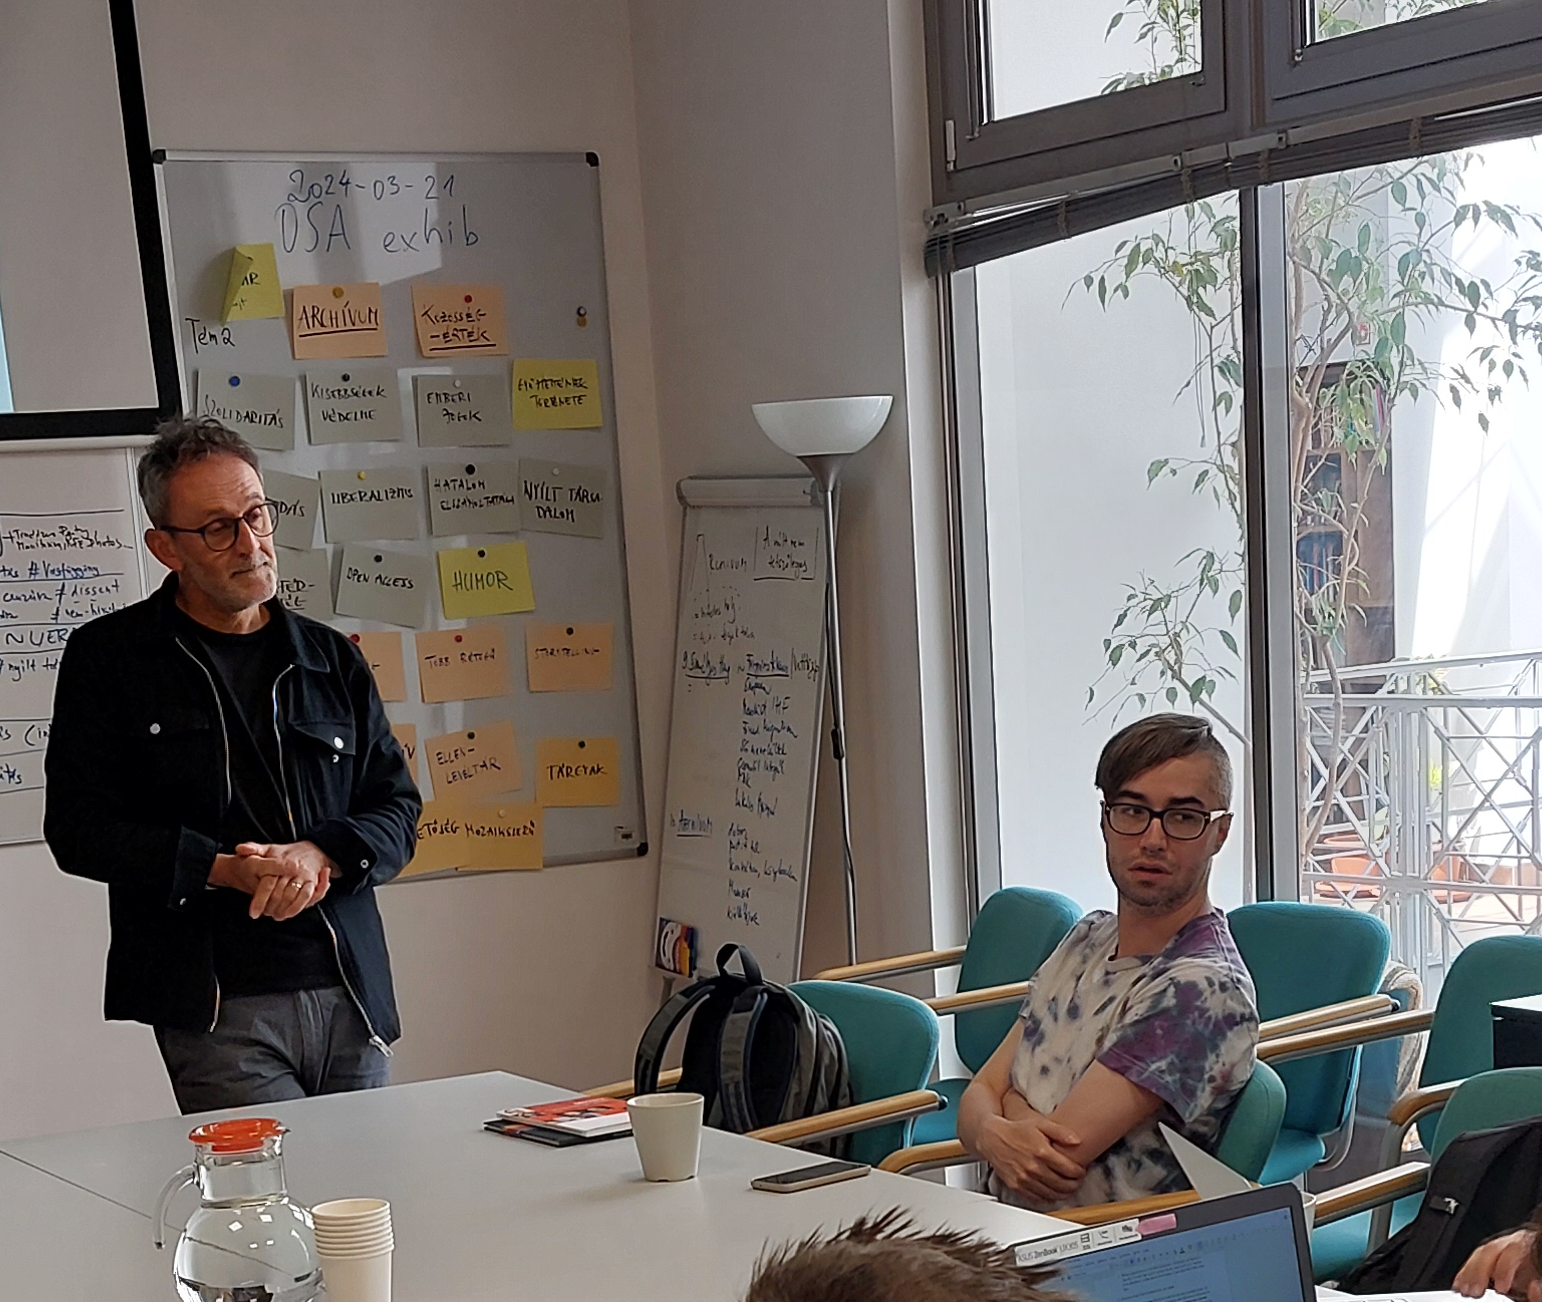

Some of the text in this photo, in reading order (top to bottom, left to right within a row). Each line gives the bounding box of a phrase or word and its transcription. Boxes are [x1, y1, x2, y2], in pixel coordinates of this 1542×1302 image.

[274, 201, 479, 254] OSA exhib
[452, 569, 514, 593] HUMOR
